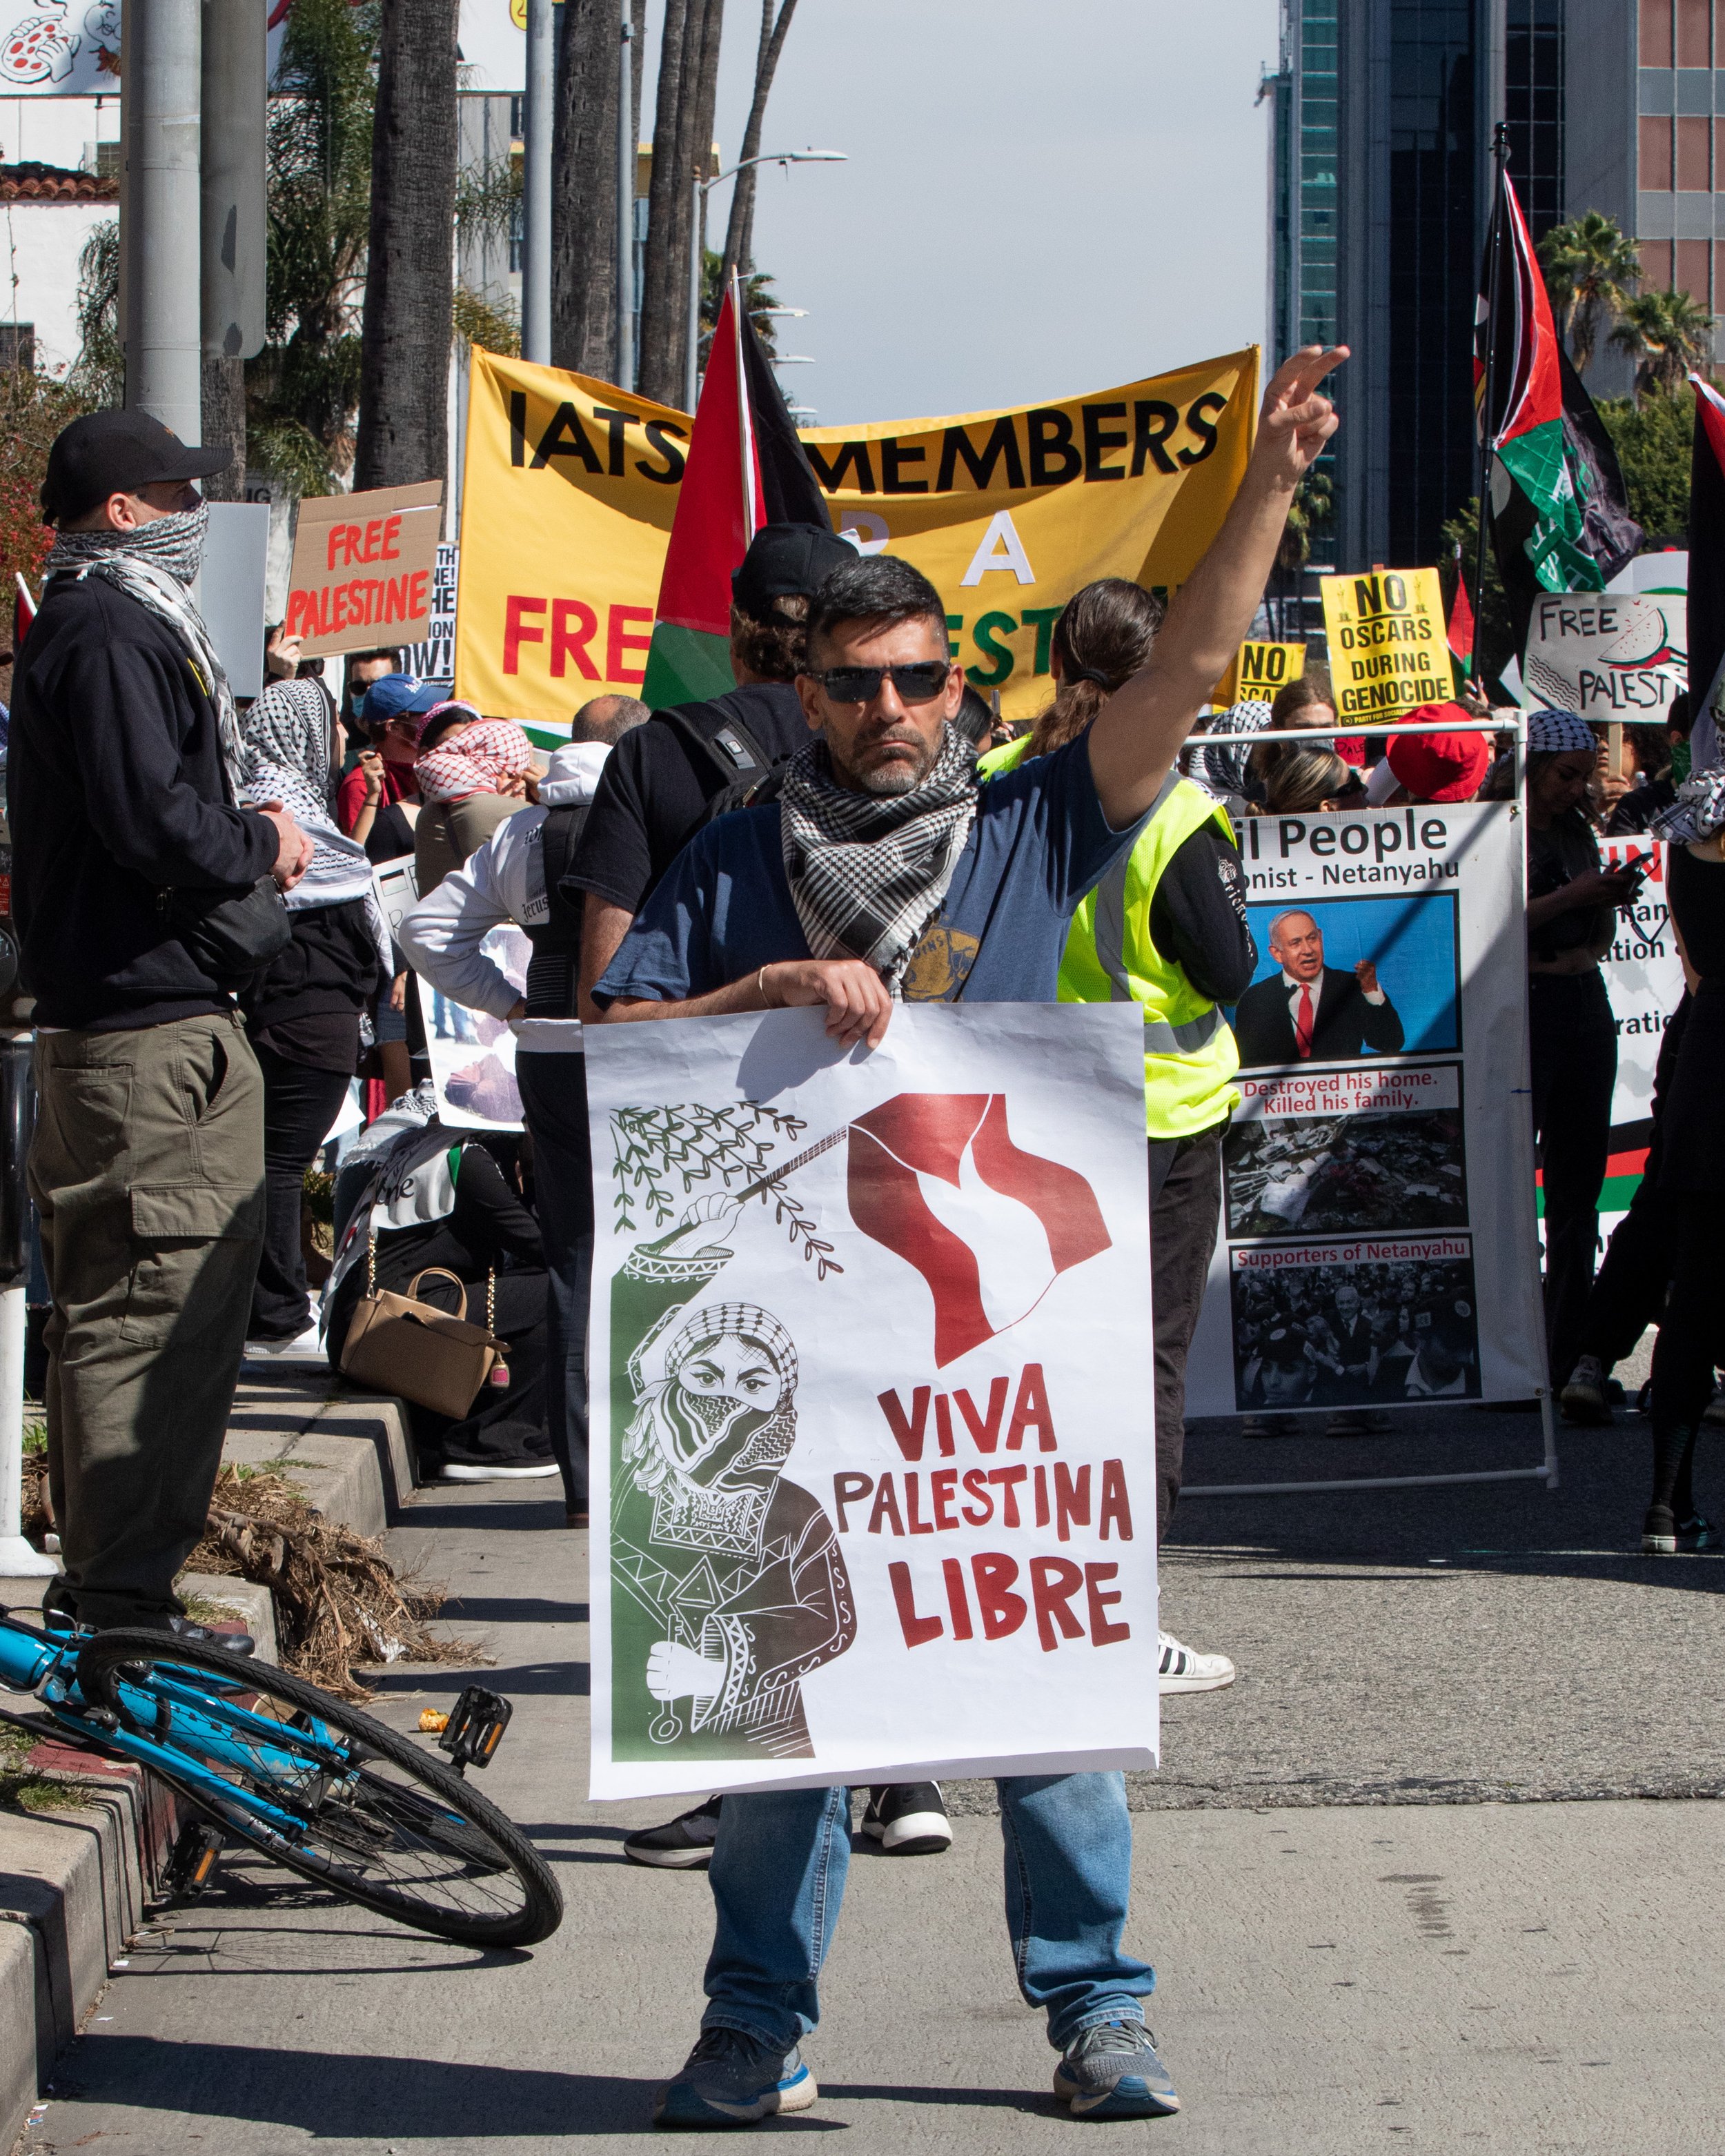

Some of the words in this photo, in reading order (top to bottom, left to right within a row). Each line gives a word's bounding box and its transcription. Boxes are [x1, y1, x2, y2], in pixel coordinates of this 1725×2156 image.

[511, 390, 690, 485] IATS
[803, 391, 1229, 495] MEMBERS
[327, 515, 402, 571] FREE
[958, 509, 1036, 587] A
[285, 569, 429, 640] PALESTINE
[1354, 574, 1407, 617] NO
[1340, 618, 1432, 649] OSCARS
[1539, 600, 1619, 642] FREE
[1241, 644, 1286, 682] NO
[1351, 651, 1431, 681] DURING
[1341, 677, 1450, 713] GENOCIDE
[1279, 808, 1448, 863] People
[1322, 857, 1459, 886] Netanyahu
[1244, 1074, 1340, 1097] Destroyed
[1346, 1074, 1372, 1090] his
[1378, 1071, 1438, 1088] home.
[1264, 1095, 1316, 1114] Killed
[1323, 1094, 1349, 1111] his
[1355, 1089, 1419, 1109] family.
[1238, 1246, 1338, 1269] Supporters
[1343, 1243, 1362, 1260] of
[1367, 1237, 1465, 1260] Netanyahu
[876, 1363, 1058, 1461] VIVA
[833, 1458, 1134, 1542] PALESTINA
[888, 1552, 1131, 1652] LIBRE
